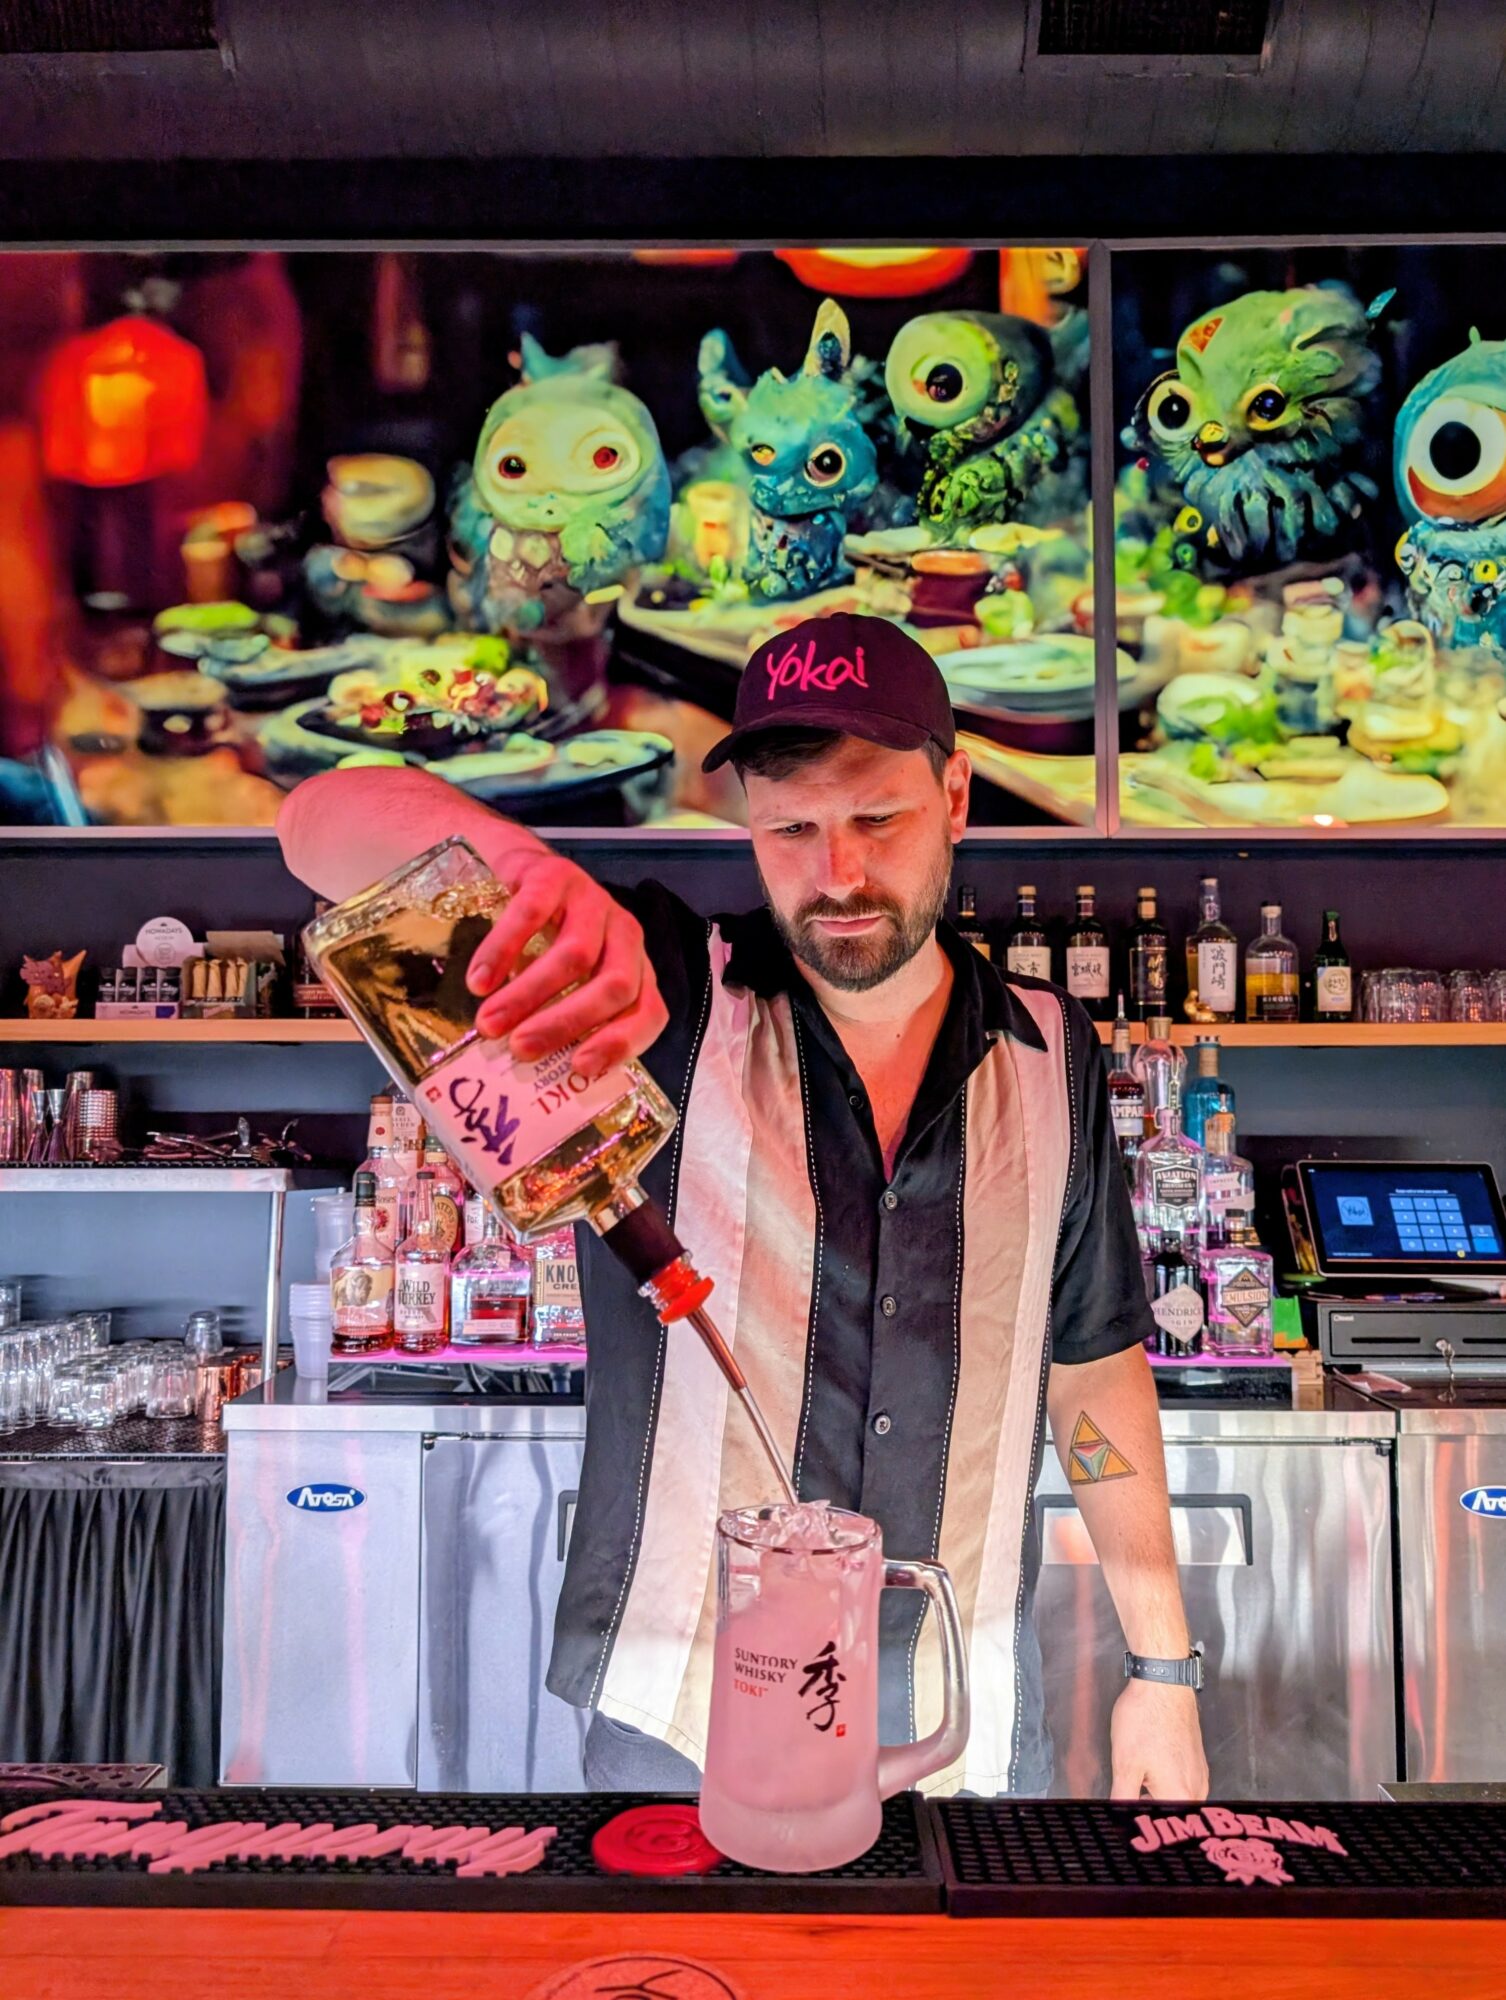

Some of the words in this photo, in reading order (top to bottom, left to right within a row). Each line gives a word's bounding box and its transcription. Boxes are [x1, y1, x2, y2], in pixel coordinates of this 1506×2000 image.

[766, 640, 869, 700] Yokai
[1156, 1170, 1197, 1180] AVIATION
[546, 1264, 577, 1283] KNO
[402, 1280, 430, 1292] WILD
[398, 1292, 436, 1305] TURKEY
[1223, 1291, 1268, 1303] EMULSION
[734, 1647, 798, 1670] SUNTORY
[734, 1662, 786, 1683] WHISKY
[798, 1641, 847, 1732] 季
[1130, 1814, 1210, 1852] JIM
[1201, 1806, 1348, 1857] BEAM
